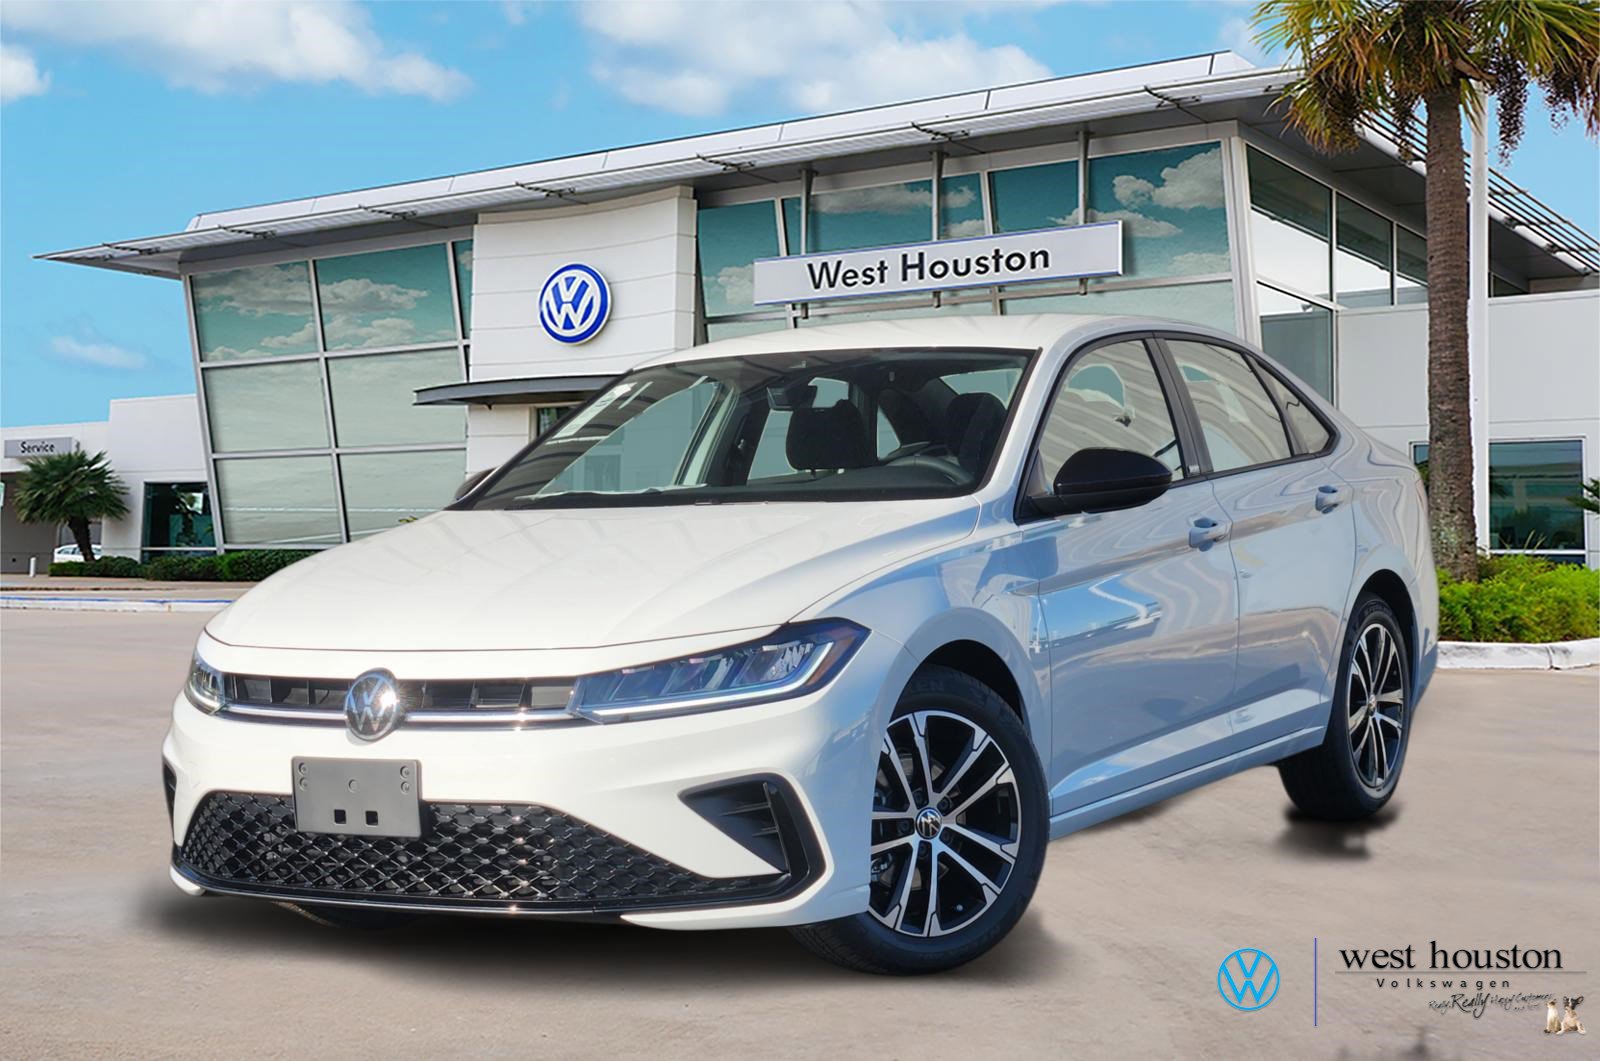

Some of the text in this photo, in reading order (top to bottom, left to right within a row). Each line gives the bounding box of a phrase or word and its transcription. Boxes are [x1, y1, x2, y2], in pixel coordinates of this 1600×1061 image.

[807, 248, 1050, 290] West Houston
[541, 265, 607, 341] VW
[20, 441, 55, 453] Service
